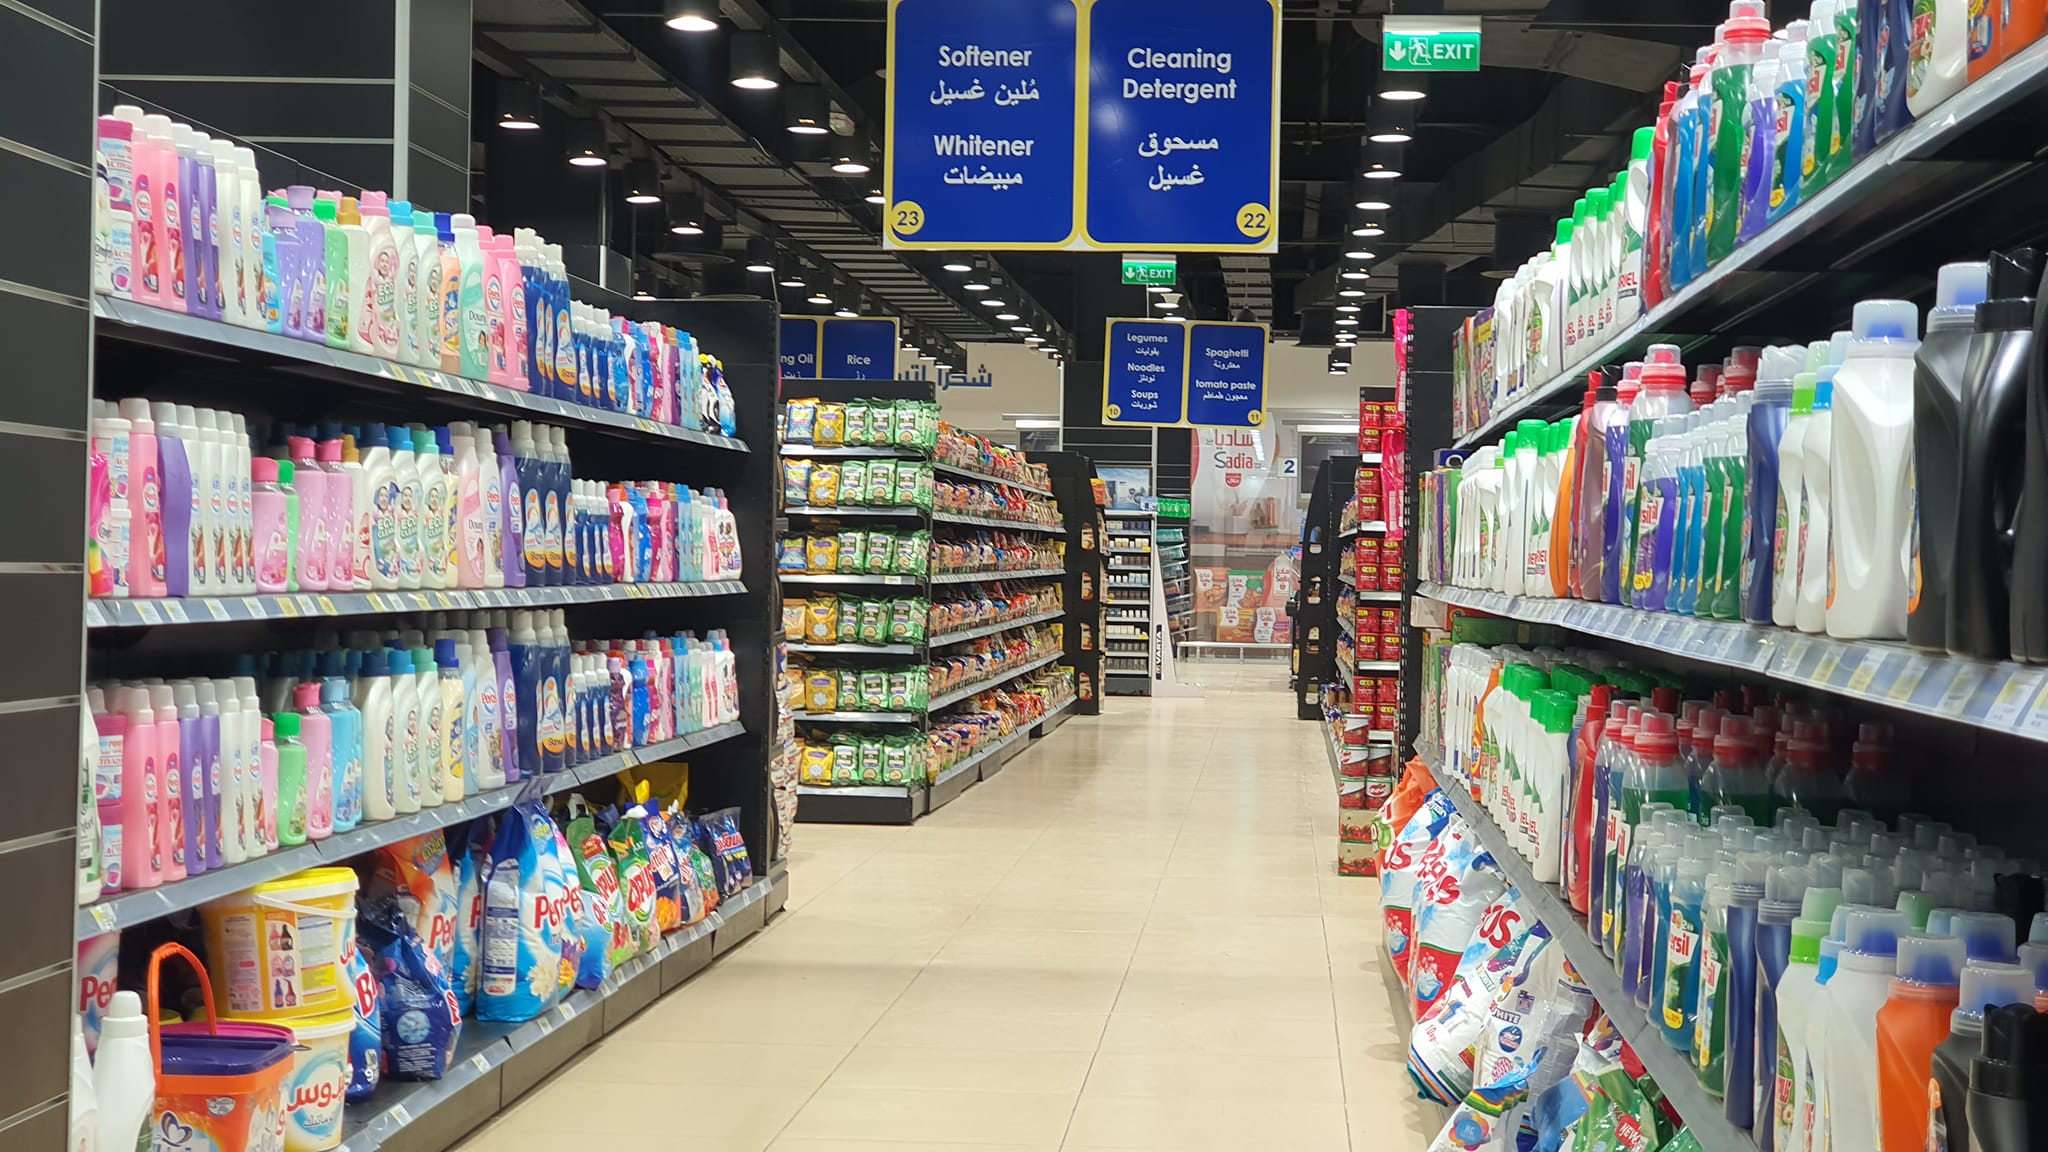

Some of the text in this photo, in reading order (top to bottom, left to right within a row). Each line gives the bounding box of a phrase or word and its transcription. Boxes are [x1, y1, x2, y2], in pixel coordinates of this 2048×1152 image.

[938, 45, 1032, 68] Softener
[1432, 43, 1475, 60] EXIT
[1127, 48, 1232, 73] Cleaning
[929, 79, 985, 107] غسيل
[1122, 78, 1237, 104] Detergent
[933, 134, 1034, 157] Whitener
[1137, 132, 1219, 157] مسحوق
[943, 166, 1023, 190] مبيضات
[1148, 163, 1205, 190] غسيل
[896, 211, 920, 227] 23
[1243, 212, 1266, 229] 22
[1149, 269, 1173, 279] EXIT
[1127, 333, 1169, 344] Legumes
[798, 353, 814, 364] Oil
[846, 354, 872, 365] Rice
[1205, 347, 1250, 359] Spaghetti
[1127, 363, 1166, 373] Noodles
[1195, 379, 1257, 391] tomato paste
[1131, 389, 1159, 400] Soups
[1109, 408, 1119, 416] 10
[1251, 413, 1260, 422] 11
[1213, 451, 1253, 469] Sadia
[1283, 459, 1295, 474] 2
